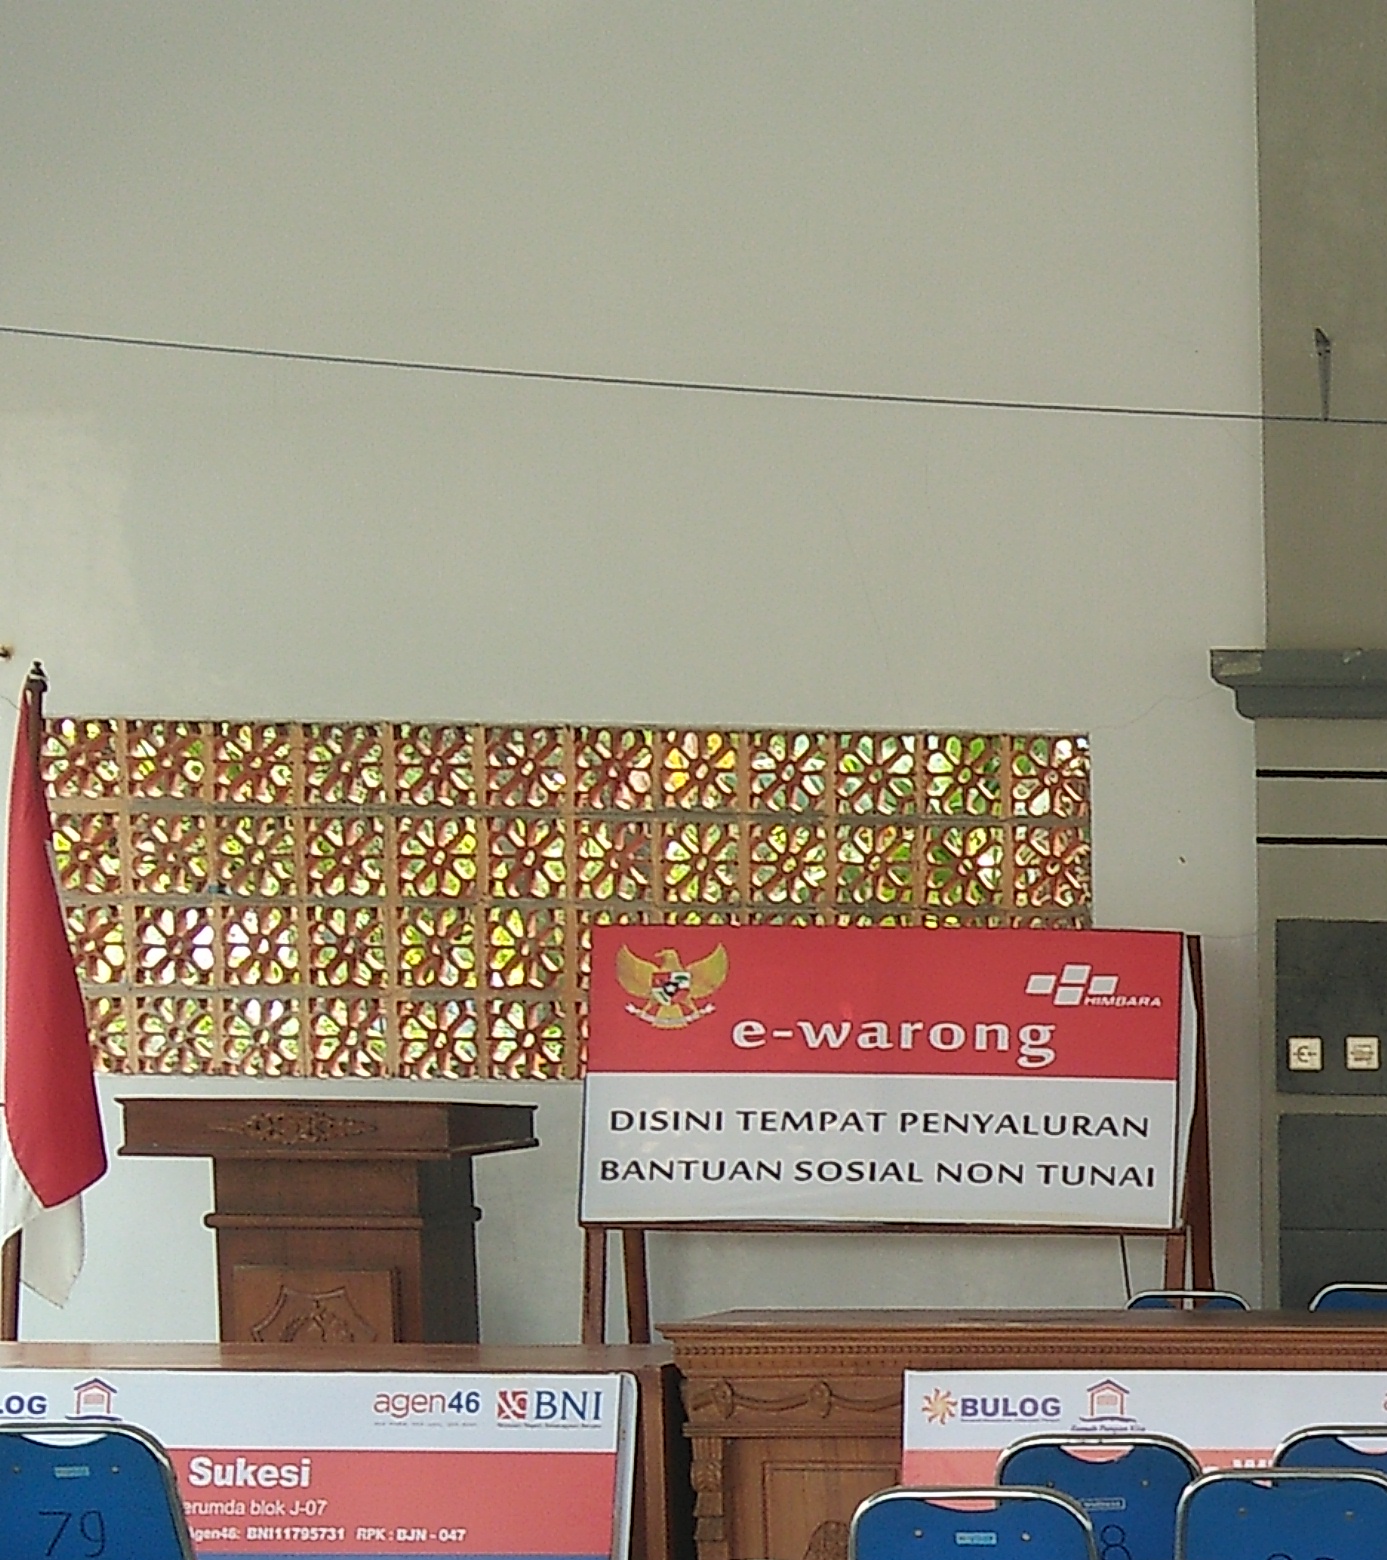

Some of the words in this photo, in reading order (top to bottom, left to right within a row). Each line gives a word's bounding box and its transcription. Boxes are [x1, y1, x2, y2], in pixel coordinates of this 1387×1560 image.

[732, 1017, 1058, 1069] e-warong
[609, 1109, 723, 1133] DISINI
[736, 1110, 887, 1134] TEMPAT
[900, 1111, 1150, 1139] PENYALURAN
[600, 1157, 782, 1184] BANTUAN
[793, 1159, 925, 1185] SOSIAL
[936, 1162, 1024, 1186] NON
[1036, 1164, 1156, 1189] TUNAI
[373, 1391, 481, 1419] agen46
[534, 1391, 603, 1420] BNI
[961, 1397, 1061, 1417] BULOG
[188, 1457, 312, 1488] Sukesi
[184, 1500, 245, 1517] erumda
[250, 1500, 285, 1516] blok
[290, 1500, 328, 1516] J-07
[38, 1510, 106, 1558] 79
[356, 1527, 386, 1541] RPK
